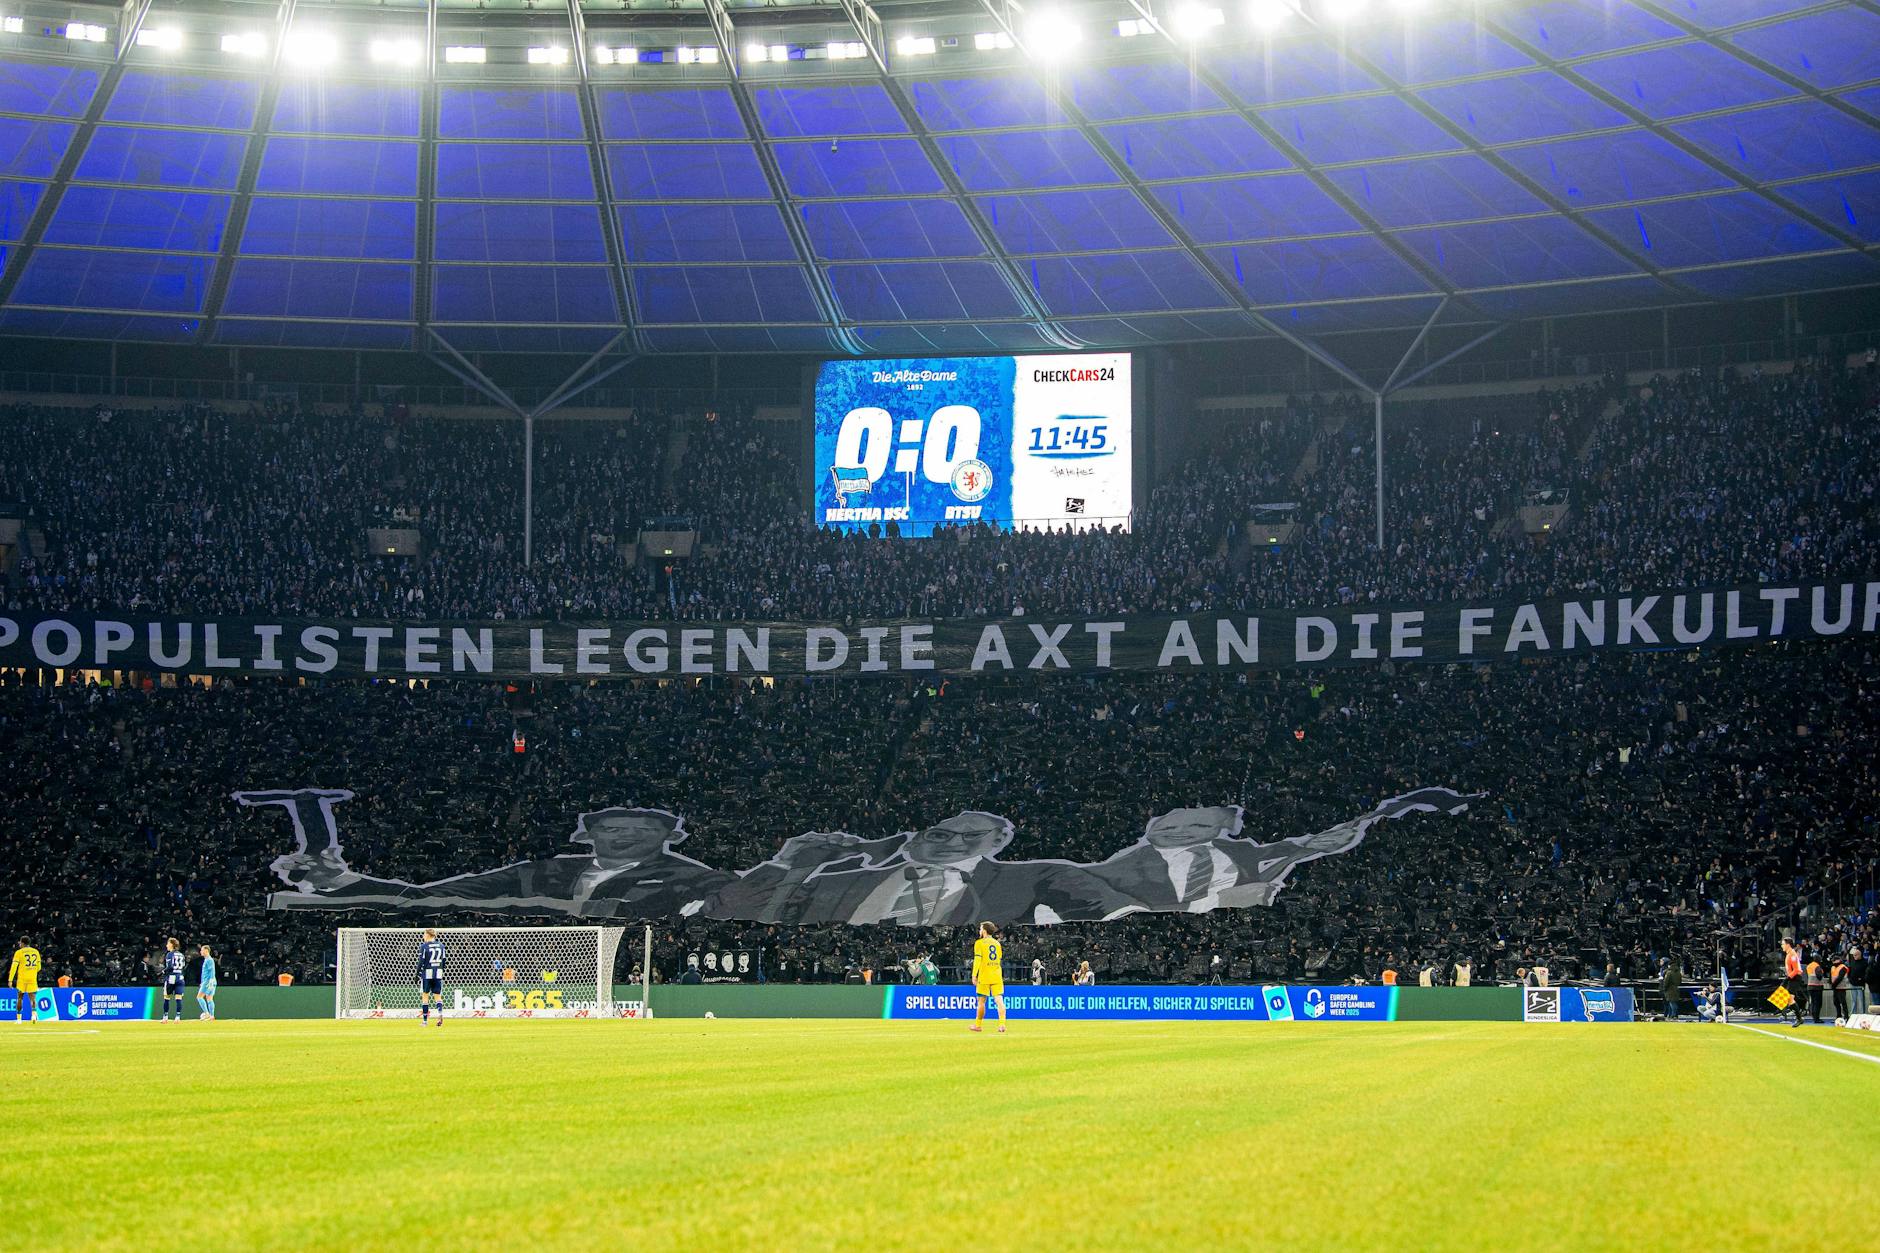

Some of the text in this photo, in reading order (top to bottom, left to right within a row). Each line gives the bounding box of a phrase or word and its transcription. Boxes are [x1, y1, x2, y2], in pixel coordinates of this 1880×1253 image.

[835, 405, 981, 484] 0:0
[1028, 425, 1107, 450] 11:45
[826, 506, 910, 521] HERTHA BSC
[529, 628, 770, 674] LEGEN
[806, 625, 935, 672] DIE
[971, 622, 1125, 670] AXT
[1158, 617, 1258, 667] AN
[1296, 611, 1424, 662] DIE
[24, 953, 38, 967] 32
[429, 948, 442, 963] 22
[989, 945, 997, 961] 8
[173, 955, 183, 970] 33
[454, 989, 563, 1009] bet365
[906, 996, 935, 1010] SPIEL
[1004, 997, 1027, 1009] GIBT
[1029, 997, 1065, 1011] TOOLS,
[1068, 997, 1085, 1010] DIE
[1088, 997, 1106, 1010] DIR
[1108, 997, 1150, 1011] HELFEN,
[1153, 997, 1192, 1010] SICHER
[1194, 997, 1207, 1010] ZU
[1210, 997, 1254, 1010] SPIELEN
